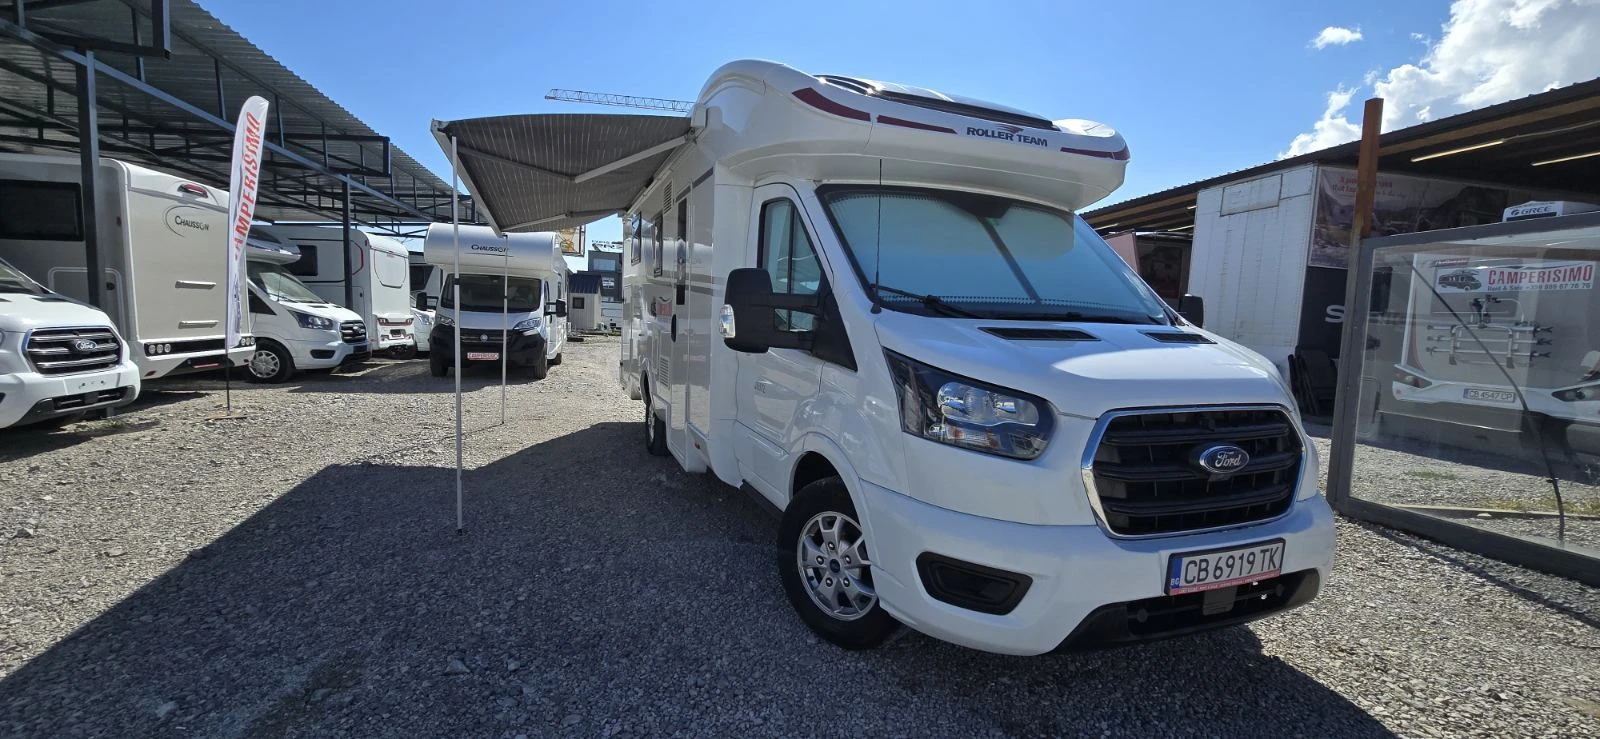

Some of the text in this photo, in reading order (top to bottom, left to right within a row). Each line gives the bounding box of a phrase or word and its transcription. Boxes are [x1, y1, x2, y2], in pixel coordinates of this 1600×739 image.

[966, 127, 1048, 147] ROLLER TEAM
[234, 111, 261, 261] AMPERISIMO
[1521, 206, 1552, 215] GREE
[174, 215, 209, 231] CHAUSSON
[1488, 265, 1594, 285] CAMPERISIMO
[1215, 450, 1242, 467] Ford
[1184, 558, 1209, 584] CB
[1213, 551, 1256, 580] 6919
[1260, 546, 1280, 571] TK
[1171, 577, 1180, 586] BG
